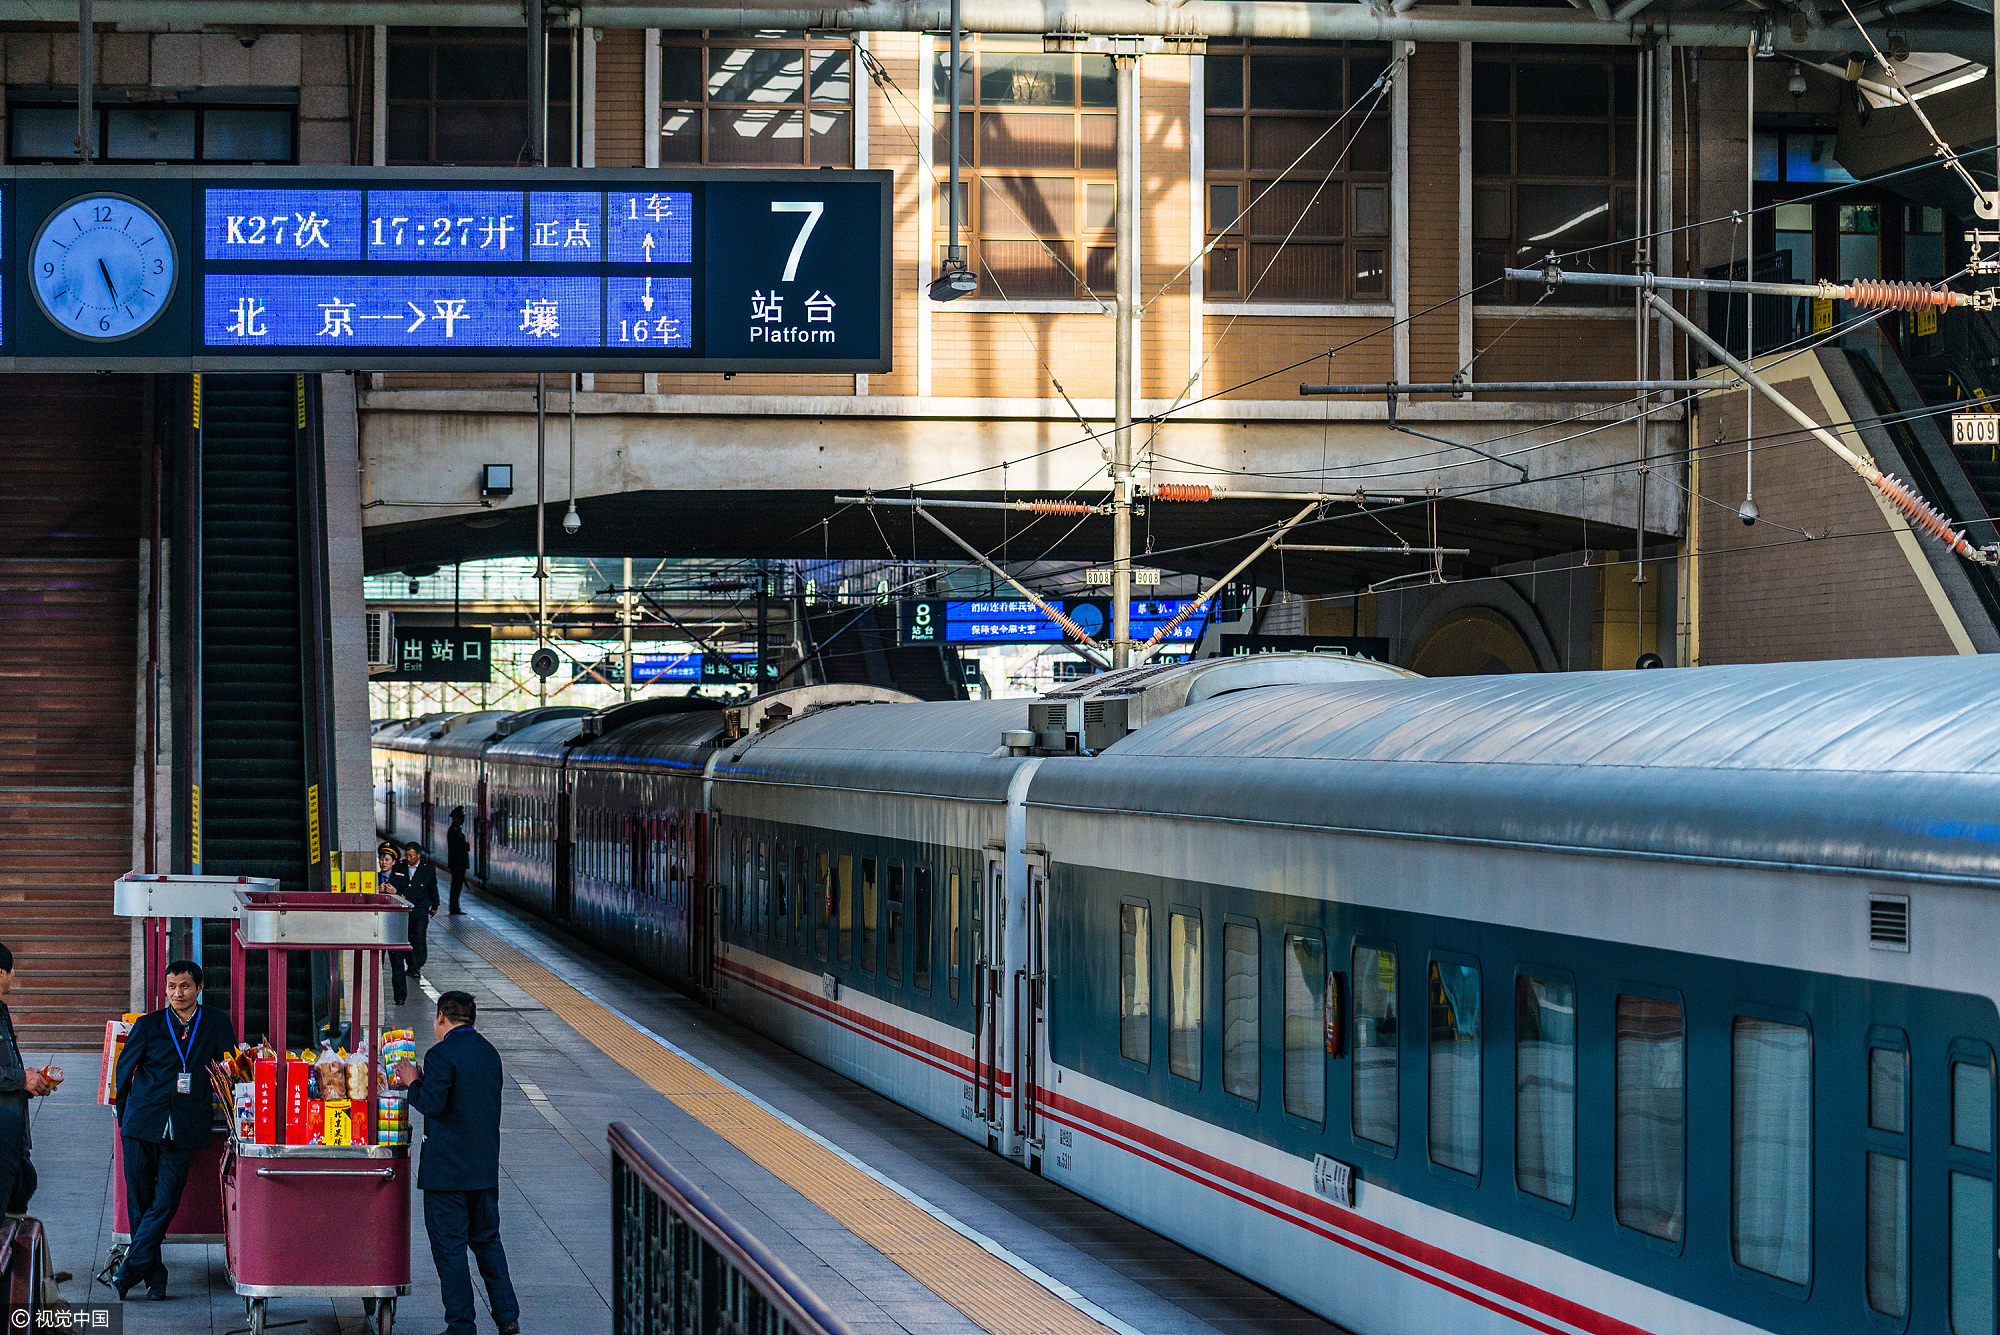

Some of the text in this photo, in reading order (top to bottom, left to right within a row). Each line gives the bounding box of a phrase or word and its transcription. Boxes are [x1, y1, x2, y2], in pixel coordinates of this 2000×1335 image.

[93, 206, 112, 223] 12
[628, 193, 673, 222] 1车
[226, 211, 330, 249] K27次
[371, 214, 515, 250] 17:27开
[531, 219, 591, 248] 正点
[771, 201, 824, 282] 7
[43, 262, 55, 279] 9
[153, 259, 164, 275] 3
[750, 289, 837, 323] 站台
[99, 315, 110, 332] 6
[618, 315, 681, 345] 16车
[750, 326, 836, 343] Platform
[1956, 420, 1995, 442] 8009
[1087, 572, 1110, 584] 8008
[1137, 572, 1159, 584] 9008
[916, 603, 931, 626] 8
[911, 625, 934, 636] 站台
[403, 638, 482, 662] 出站口
[403, 662, 423, 672] Exit
